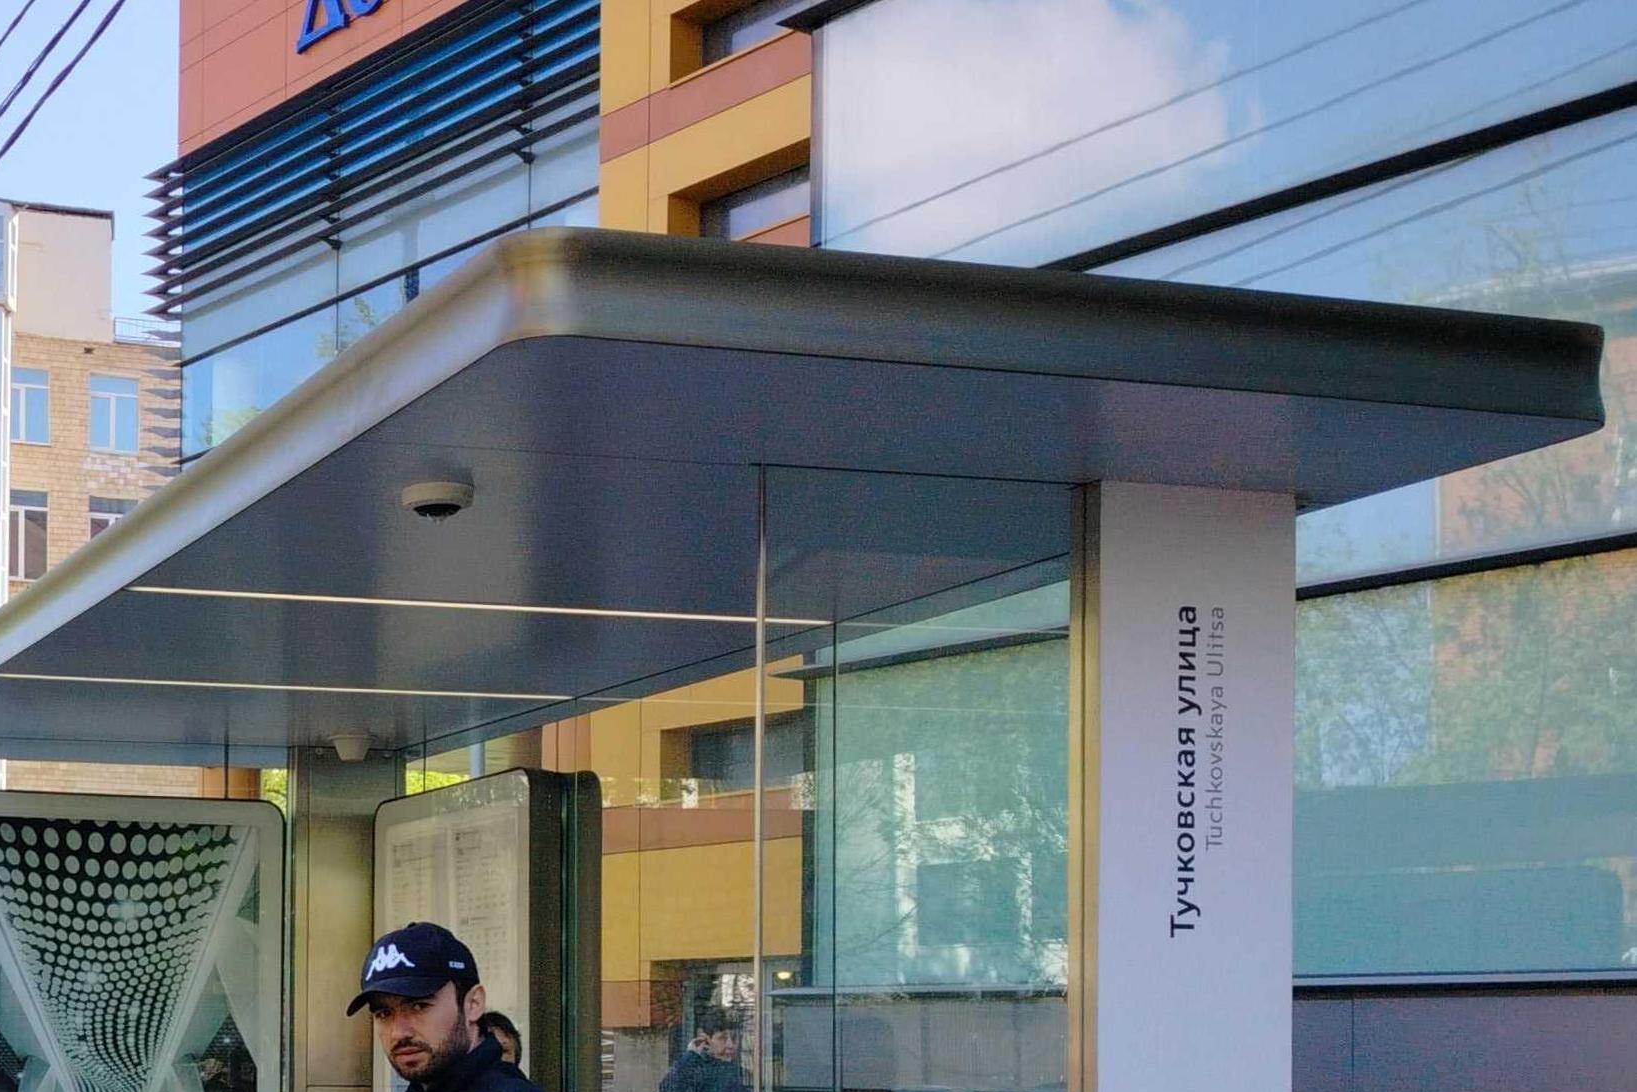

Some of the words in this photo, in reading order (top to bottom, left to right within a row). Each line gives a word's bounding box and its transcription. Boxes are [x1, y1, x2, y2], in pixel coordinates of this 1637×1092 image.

[1178, 606, 1202, 715] улица
[1206, 607, 1225, 676] Ulitsa
[1170, 727, 1201, 938] Тучковская
[1205, 686, 1228, 851] Tuchkovskaya
